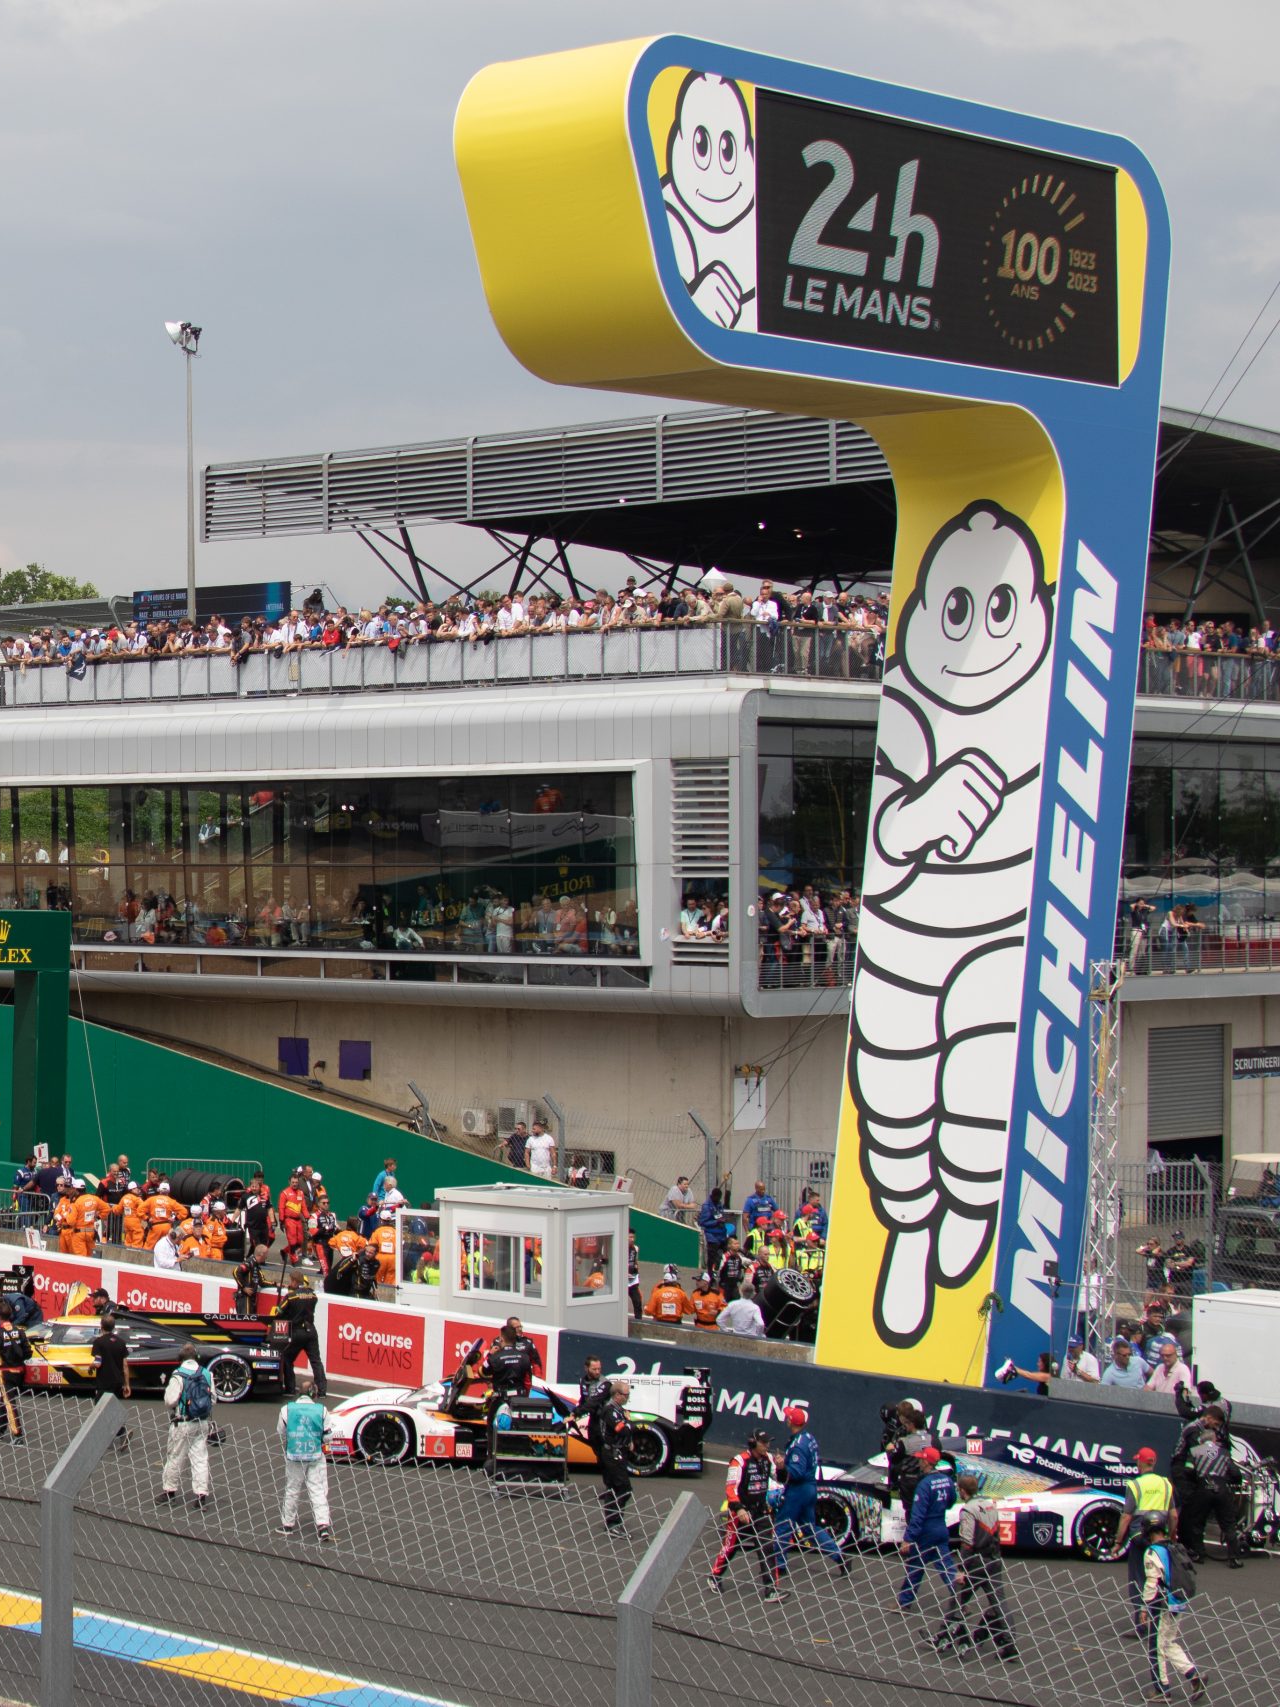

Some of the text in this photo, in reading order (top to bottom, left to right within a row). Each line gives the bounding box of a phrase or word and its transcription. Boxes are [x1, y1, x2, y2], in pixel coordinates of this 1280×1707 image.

[788, 139, 940, 288] 24h
[997, 229, 1061, 285] 100
[1068, 248, 1097, 271] 1923
[1010, 283, 1040, 300] ANS
[1066, 271, 1099, 294] 2023
[782, 275, 932, 330] LE MANS
[1010, 539, 1119, 1336] MICHELIN
[150, 1296, 192, 1313] course
[204, 1313, 258, 1321] CADILLAC
[275, 1322, 287, 1332] HY
[365, 1331, 413, 1350] course
[249, 1348, 270, 1357] Mobil
[341, 1341, 412, 1370] LE MANS
[31, 1366, 40, 1382] 3
[433, 1437, 446, 1455] 6
[456, 1449, 472, 1457] CAR
[967, 1440, 981, 1453] HY
